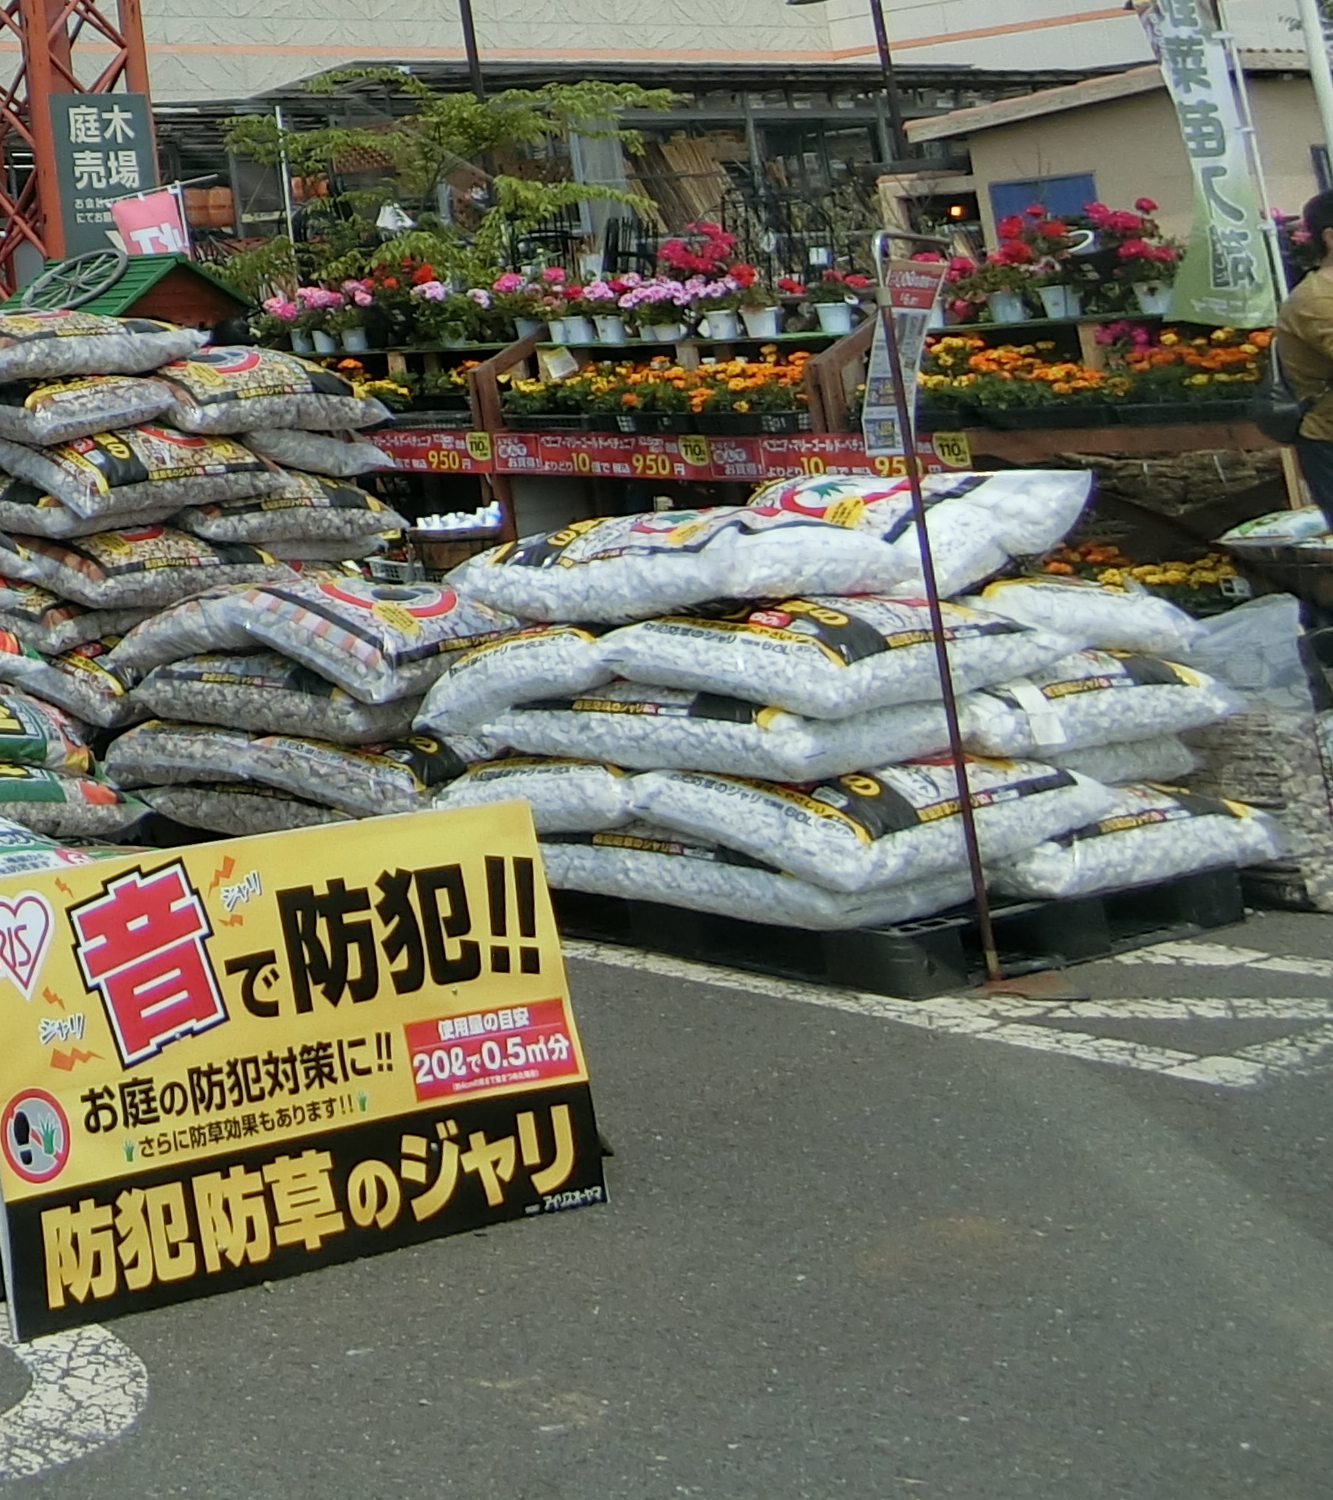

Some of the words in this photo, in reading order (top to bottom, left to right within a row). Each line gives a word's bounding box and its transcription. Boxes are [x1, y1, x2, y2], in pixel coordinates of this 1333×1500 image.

[68, 104, 135, 144] 庭木
[72, 150, 140, 190] 売場
[220, 870, 262, 912] ジャリ
[66, 856, 540, 1071] 音で防犯!!
[39, 1012, 86, 1045] ジャリ
[437, 1006, 530, 1042] 使用量の目安
[80, 1030, 394, 1135] お庭の防犯対策に!!
[138, 1093, 355, 1160] さらに防草効果もあります!!
[39, 1103, 576, 1311] 防犯防草のジャリ
